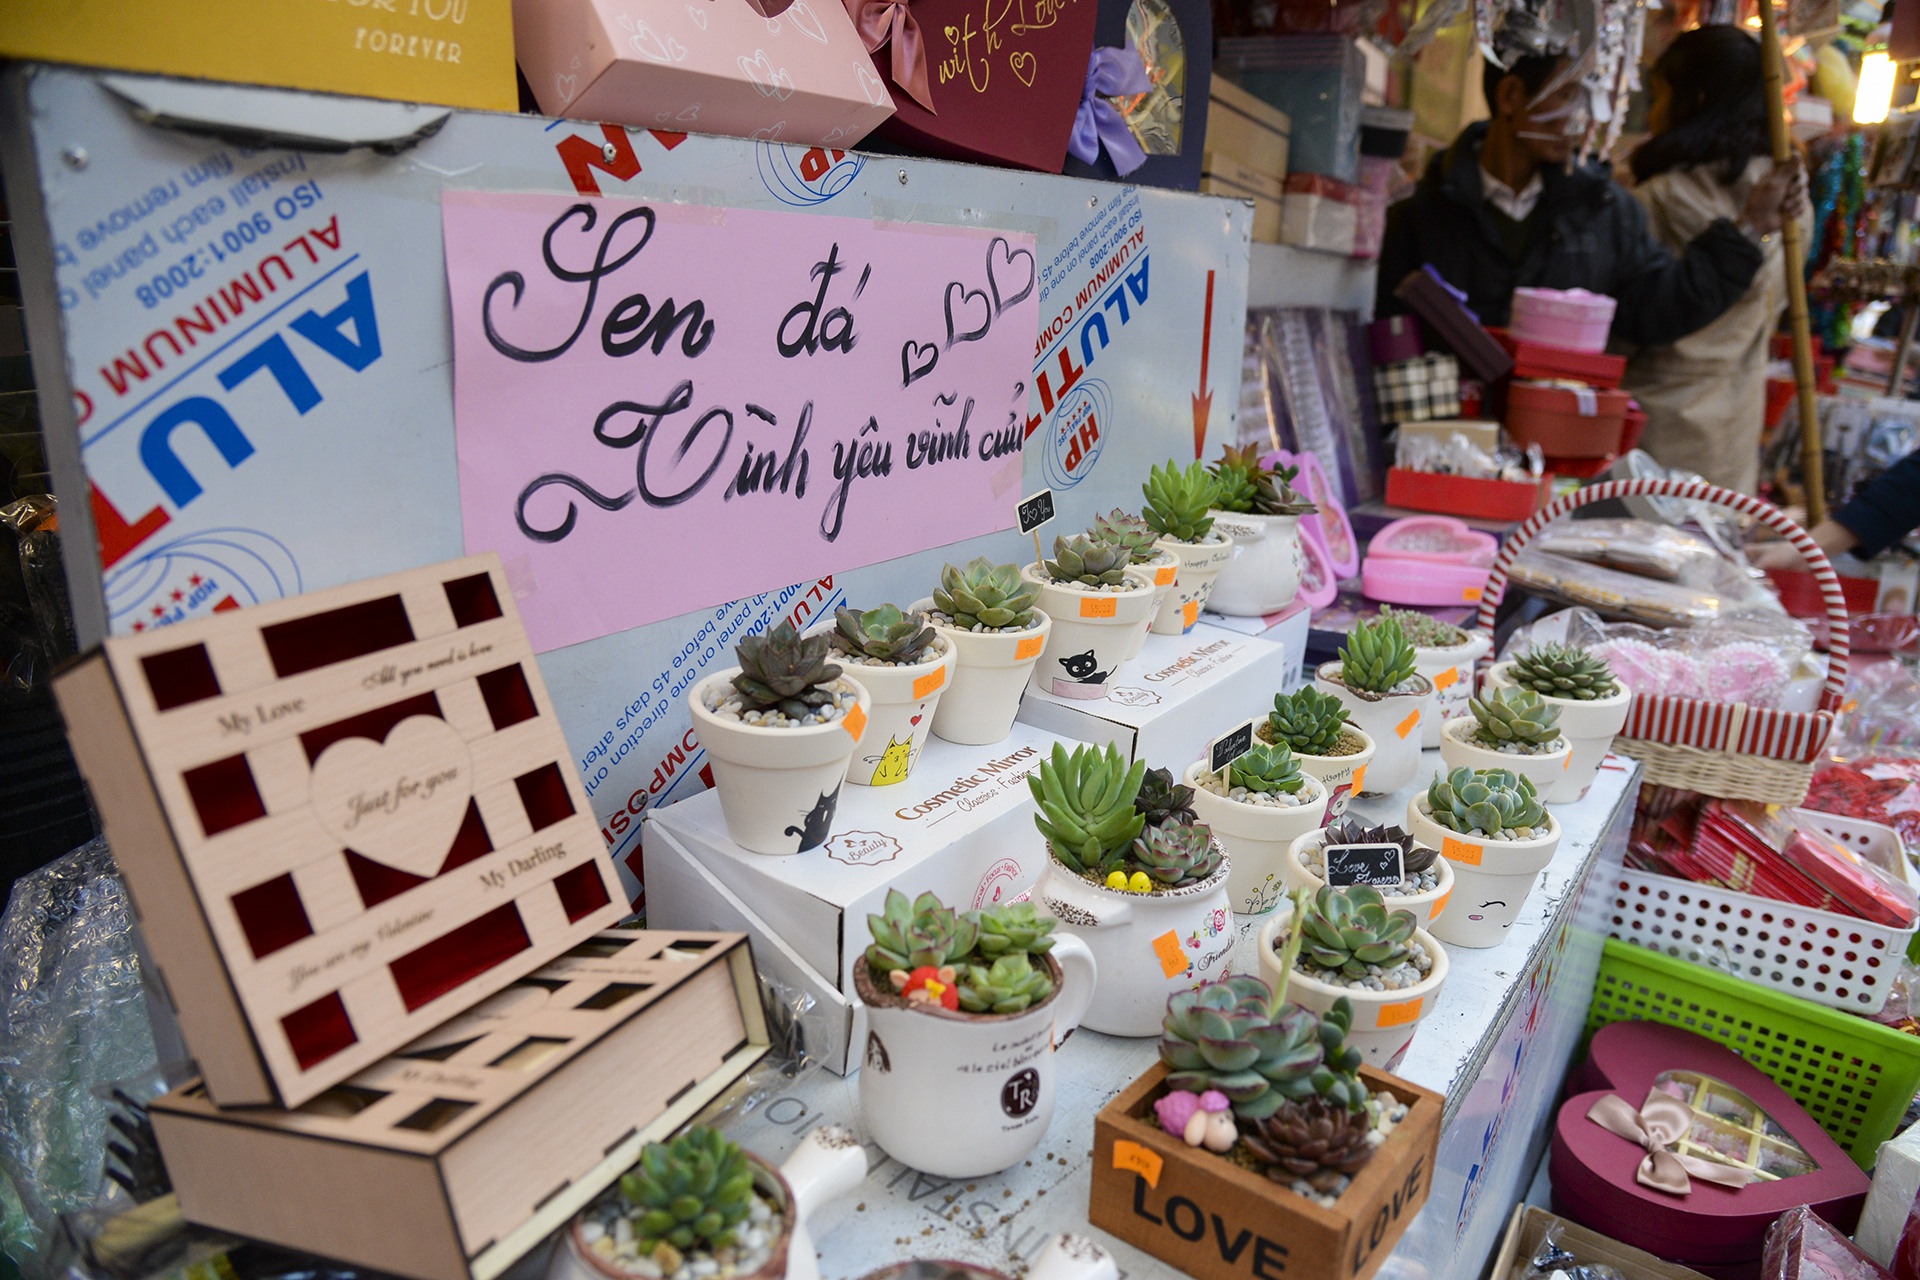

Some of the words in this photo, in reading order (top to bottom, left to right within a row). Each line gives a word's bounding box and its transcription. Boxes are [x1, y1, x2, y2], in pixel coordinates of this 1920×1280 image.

[354, 26, 462, 64] FOREVER
[182, 151, 235, 188] film
[228, 152, 307, 208] Install
[76, 180, 182, 250] remove
[160, 195, 226, 244] each
[274, 179, 323, 220] ISO
[1107, 194, 1122, 211] film
[1119, 194, 1139, 222] Install
[1128, 208, 1143, 229] ISO
[1079, 209, 1107, 240] remove
[1100, 216, 1118, 238] each
[81, 231, 159, 299] panel
[135, 211, 272, 309] 9001:2008
[1053, 237, 1079, 267] before
[1066, 257, 1078, 272] on
[1079, 233, 1099, 263] panel
[1089, 223, 1128, 269] 9001:2008
[482, 202, 715, 363] Sen
[777, 241, 871, 358] đá
[1042, 265, 1053, 281] 45
[1050, 269, 1066, 290] one
[1075, 225, 1144, 310] ALUMINUM
[101, 214, 343, 395] ALUMINUM
[1065, 412, 1099, 472] HP
[819, 416, 894, 542] yêu
[906, 390, 975, 469] vĩnh
[671, 620, 717, 669] before
[716, 602, 752, 650] panel
[697, 646, 715, 668] on
[1143, 655, 1203, 682] Cosmetic
[652, 668, 671, 695] 45
[671, 667, 696, 698] one
[217, 712, 251, 738] My
[255, 699, 305, 724] Love
[616, 691, 651, 731] days
[581, 729, 615, 772] after
[609, 698, 669, 766] direction
[344, 788, 389, 831] Just
[385, 776, 420, 814] for
[420, 767, 459, 799] you
[895, 773, 989, 821] Cosmetic
[976, 745, 1038, 779] Mirror
[998, 768, 1036, 790] Fashion
[479, 868, 509, 892] My
[509, 838, 568, 882] Darling
[848, 837, 888, 861] Beauty
[1328, 849, 1370, 875] Love
[1008, 1079, 1034, 1110] TR
[1133, 1173, 1290, 1280] LOVE
[1352, 1155, 1425, 1276] LOVE
